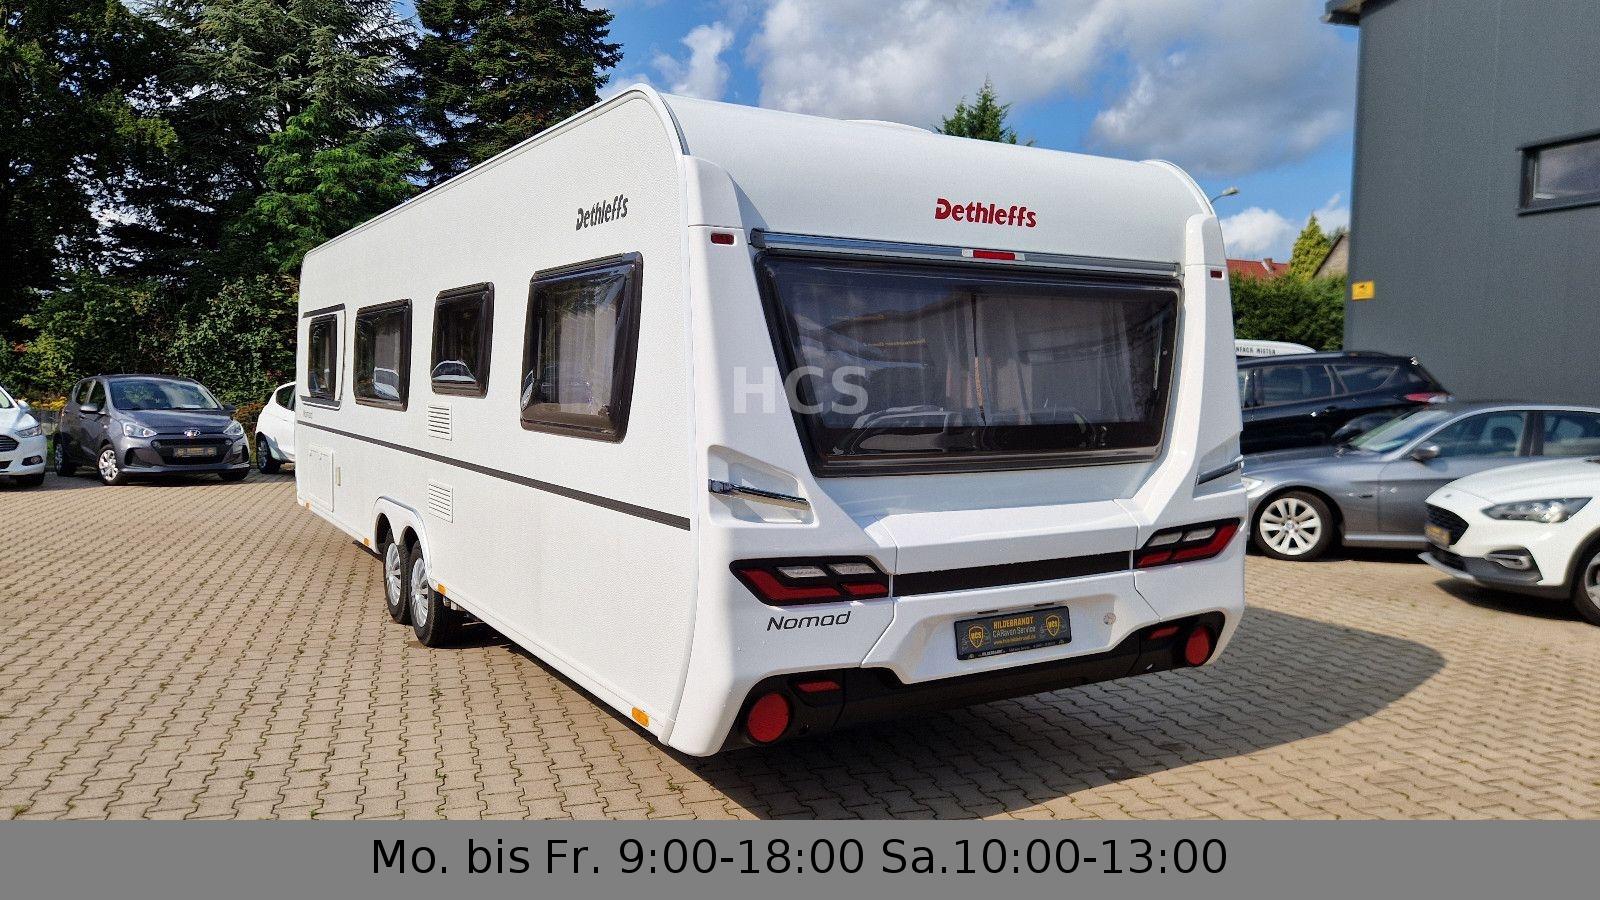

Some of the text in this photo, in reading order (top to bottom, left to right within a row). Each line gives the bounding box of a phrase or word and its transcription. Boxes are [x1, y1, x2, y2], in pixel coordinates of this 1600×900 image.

[576, 194, 629, 231] Dethleffs
[935, 198, 1037, 228] Dethleffs
[766, 611, 851, 631] Nomad
[993, 616, 1034, 630] HILDEBRANDT
